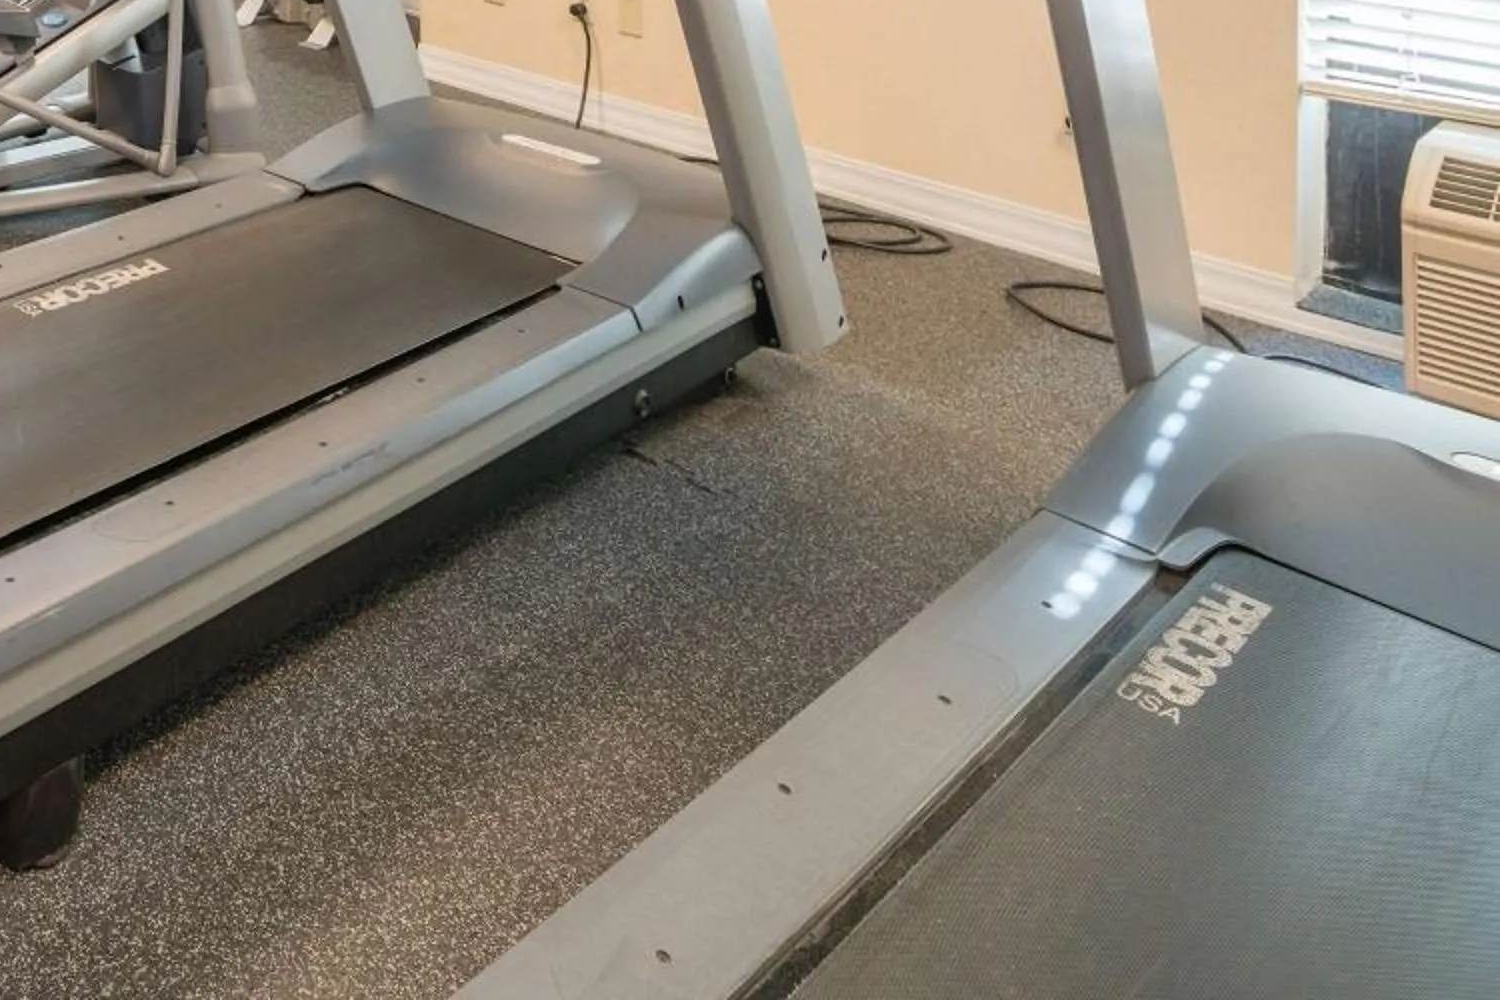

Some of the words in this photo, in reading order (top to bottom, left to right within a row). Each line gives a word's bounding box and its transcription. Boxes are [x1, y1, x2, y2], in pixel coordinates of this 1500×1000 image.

[32, 258, 172, 311] PRECOR
[1132, 582, 1273, 707] PRECOR
[1116, 674, 1181, 726] USA
